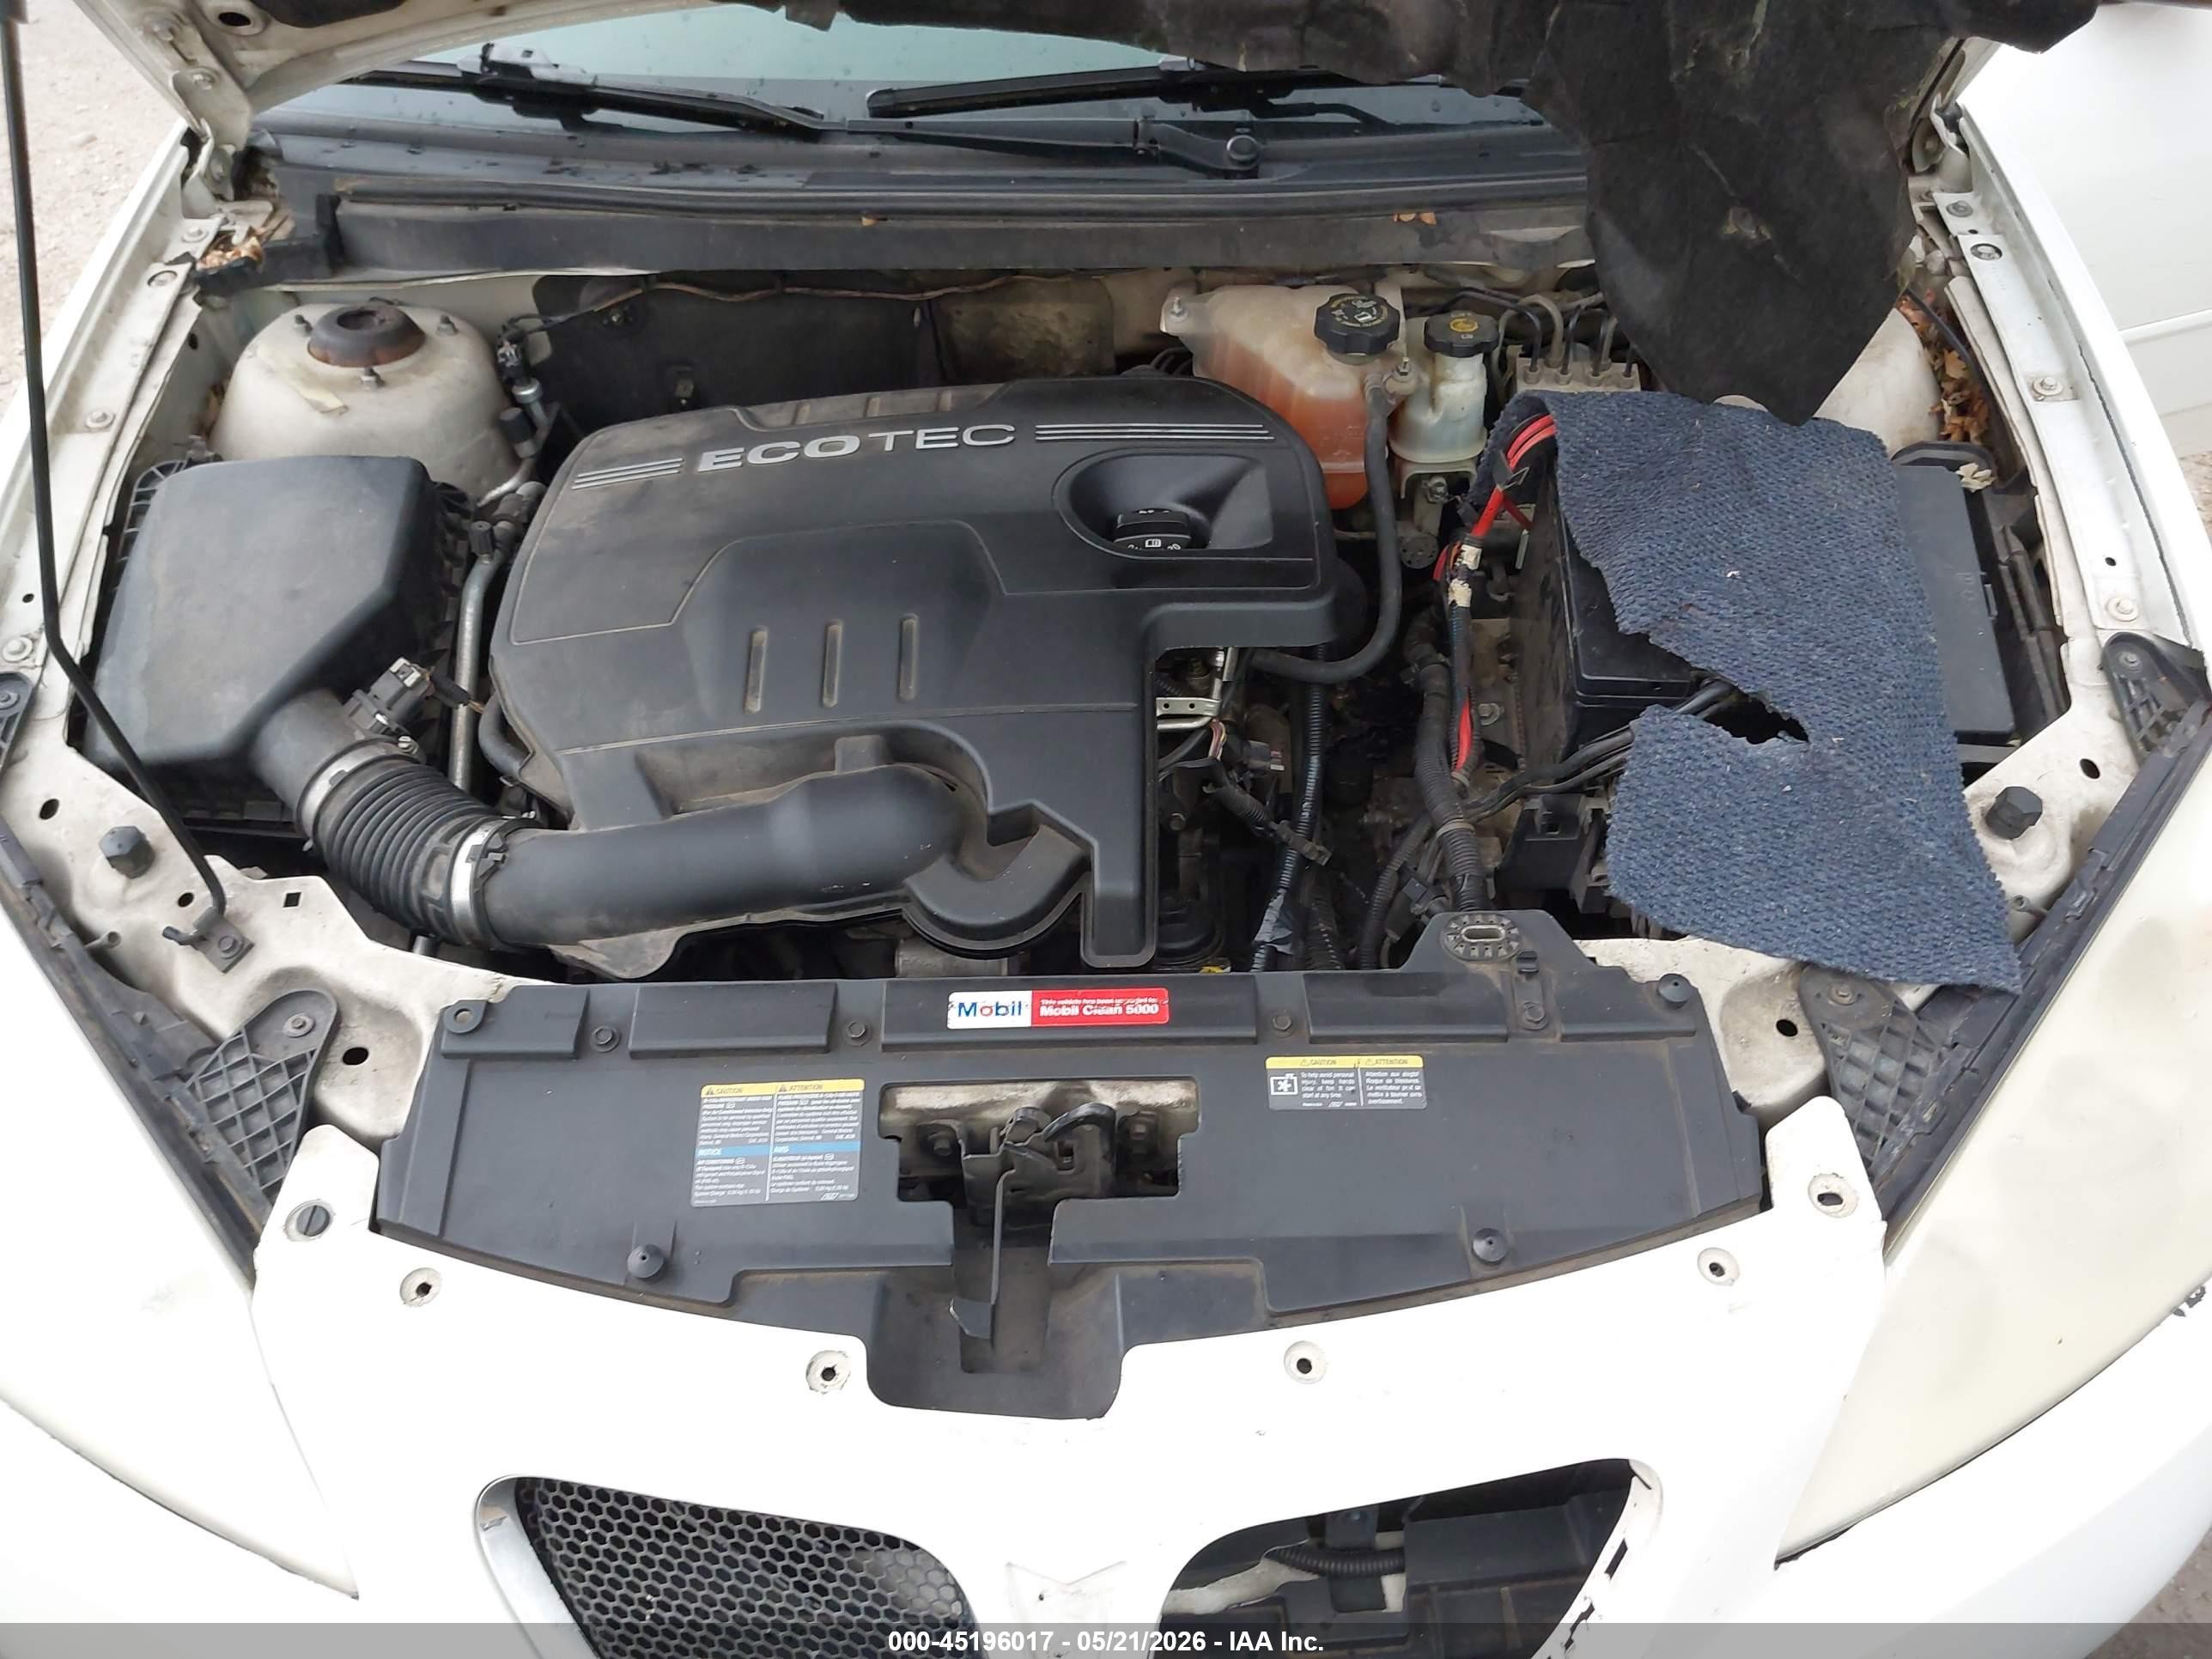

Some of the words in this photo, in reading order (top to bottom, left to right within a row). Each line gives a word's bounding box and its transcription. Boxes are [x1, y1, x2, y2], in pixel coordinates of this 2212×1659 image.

[697, 424, 1017, 472] ECOTEC
[957, 1000, 1022, 1017] Mobil
[1039, 1006, 1079, 1017] Mobil
[1082, 1005, 1123, 1016] Clean
[1125, 1004, 1159, 1015] 5000
[697, 1147, 722, 1156] NOTICE
